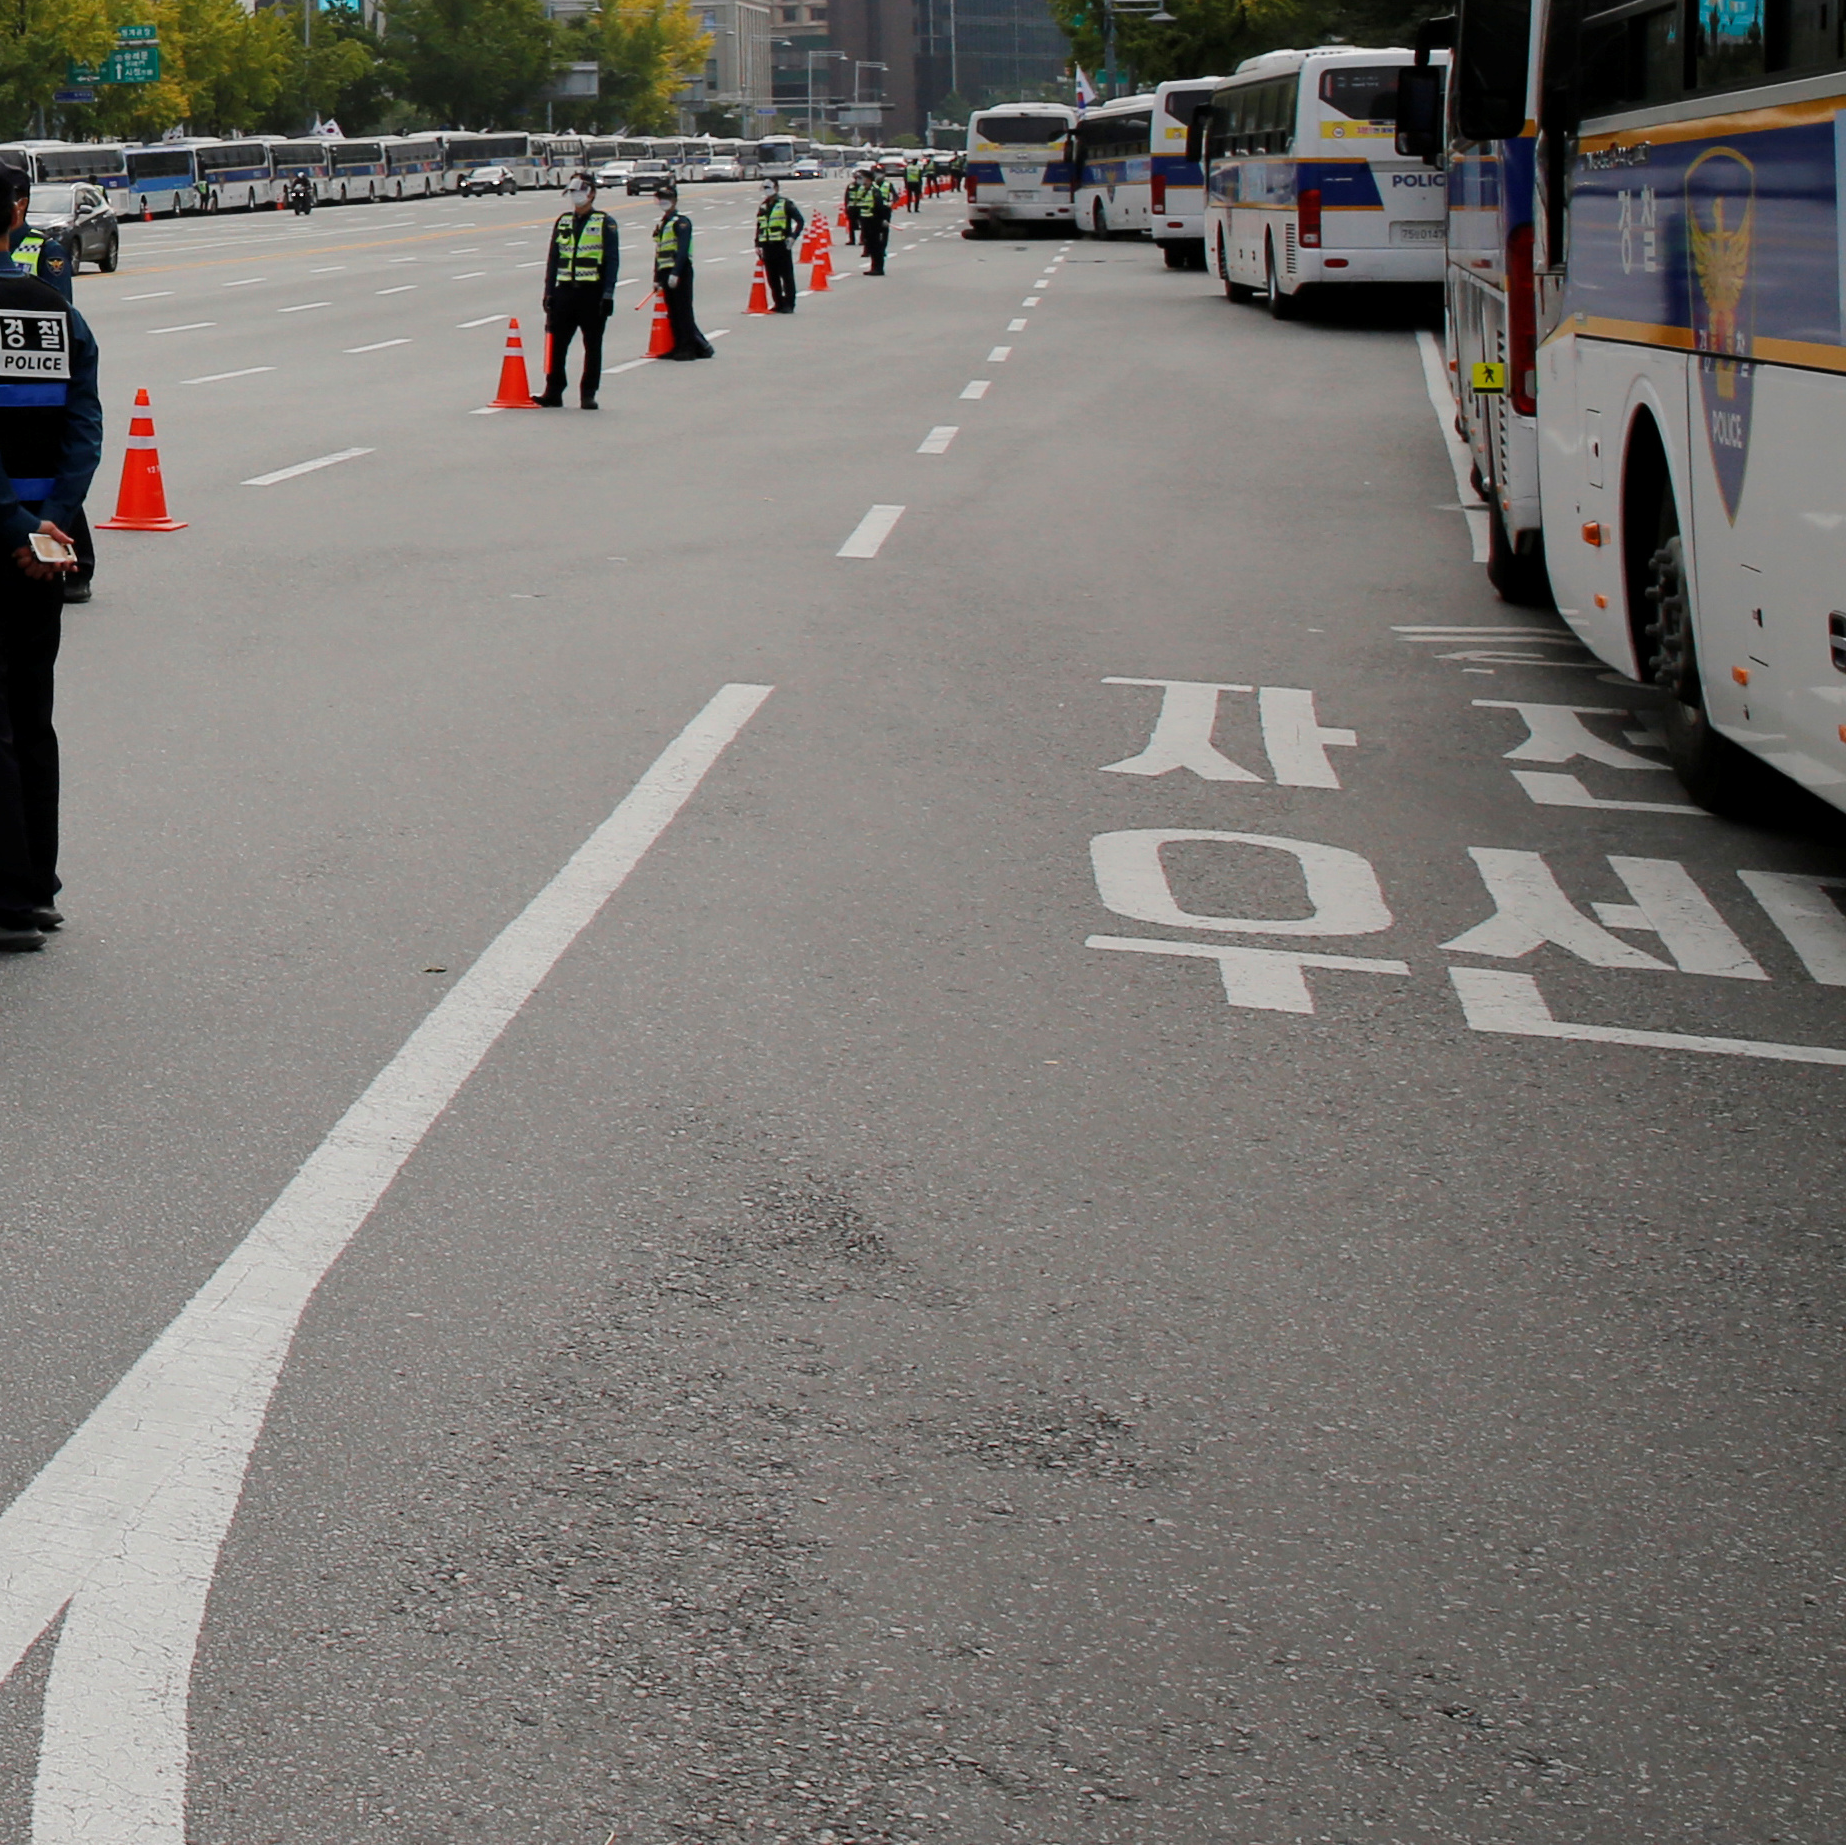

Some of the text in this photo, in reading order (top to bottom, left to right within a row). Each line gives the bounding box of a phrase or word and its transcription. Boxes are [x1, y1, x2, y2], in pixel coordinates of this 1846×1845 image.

[1392, 174, 1446, 188] POLIC
[1618, 184, 1656, 275] 경찰
[4, 318, 61, 350] 경찰
[4, 355, 62, 372] POLICE
